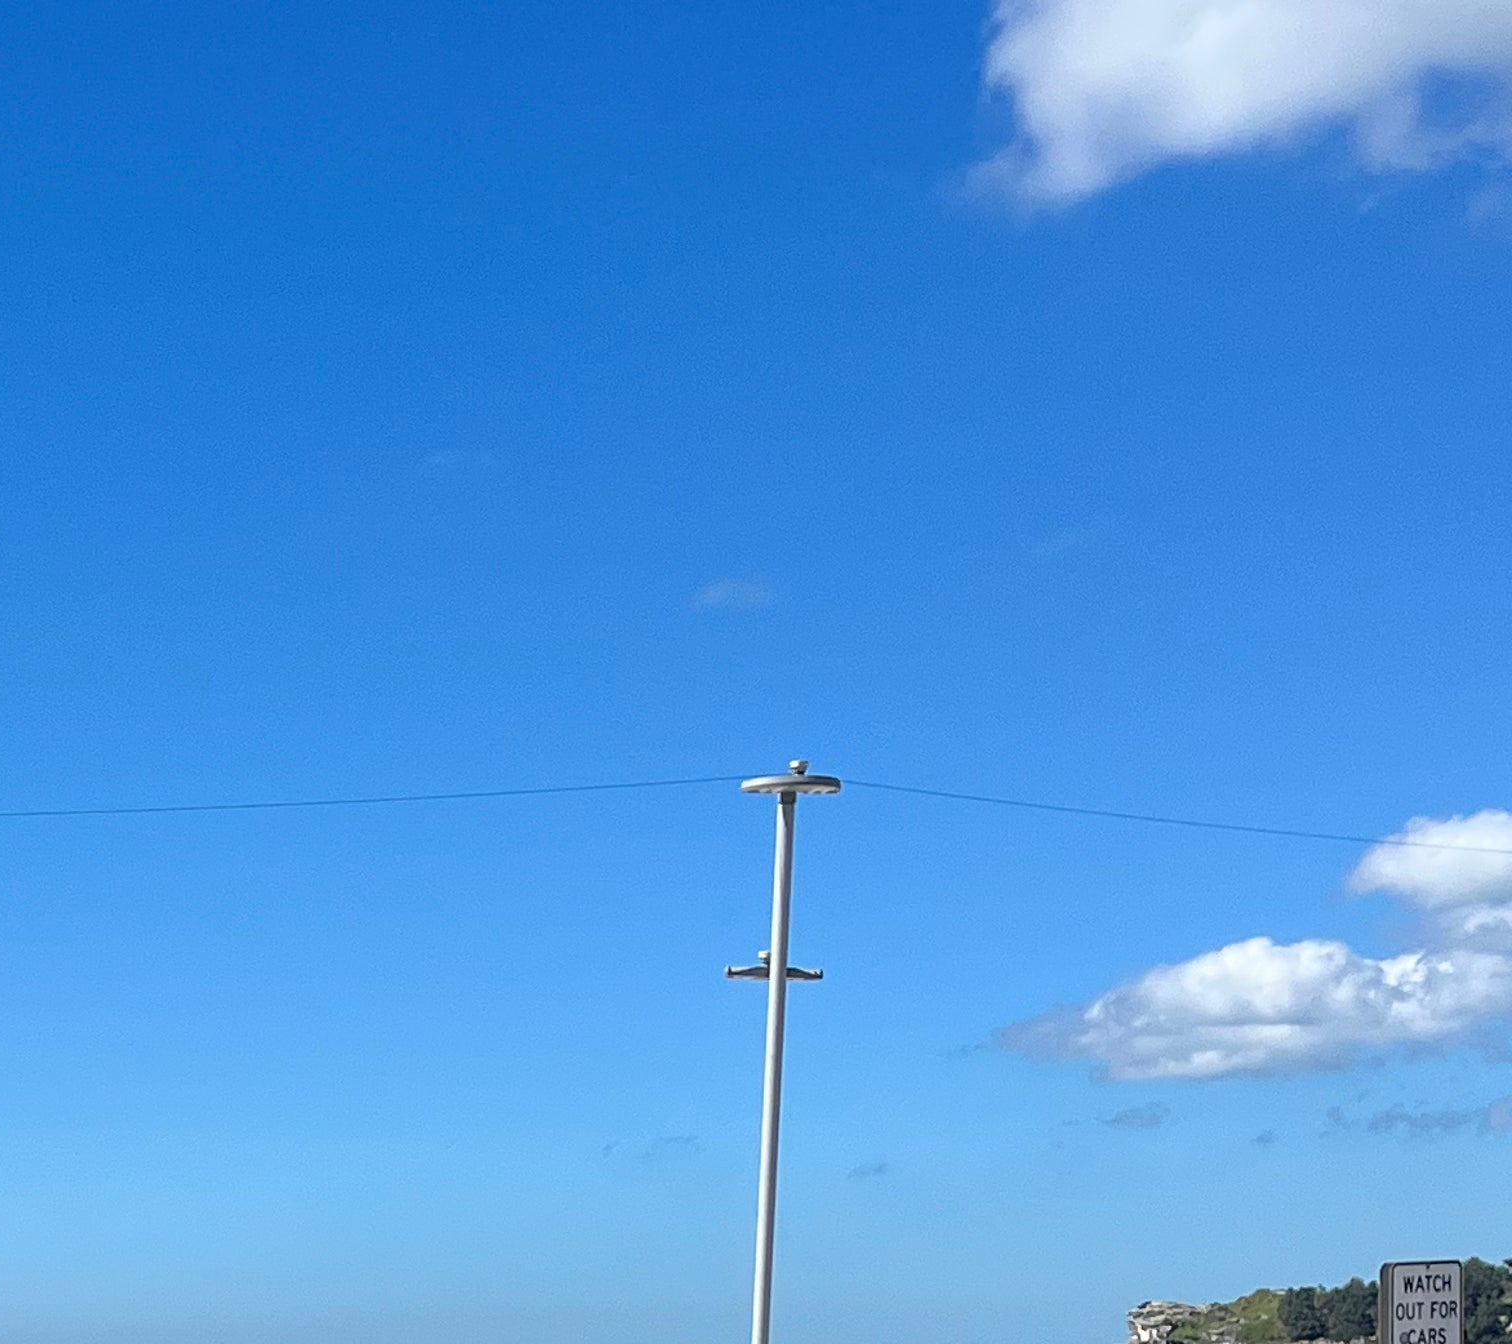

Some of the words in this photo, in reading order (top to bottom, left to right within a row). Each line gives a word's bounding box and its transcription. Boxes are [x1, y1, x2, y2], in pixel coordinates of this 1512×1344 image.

[1403, 1274, 1452, 1294] WATCH
[1395, 1302, 1424, 1321] OUT
[1430, 1301, 1458, 1319] FOR
